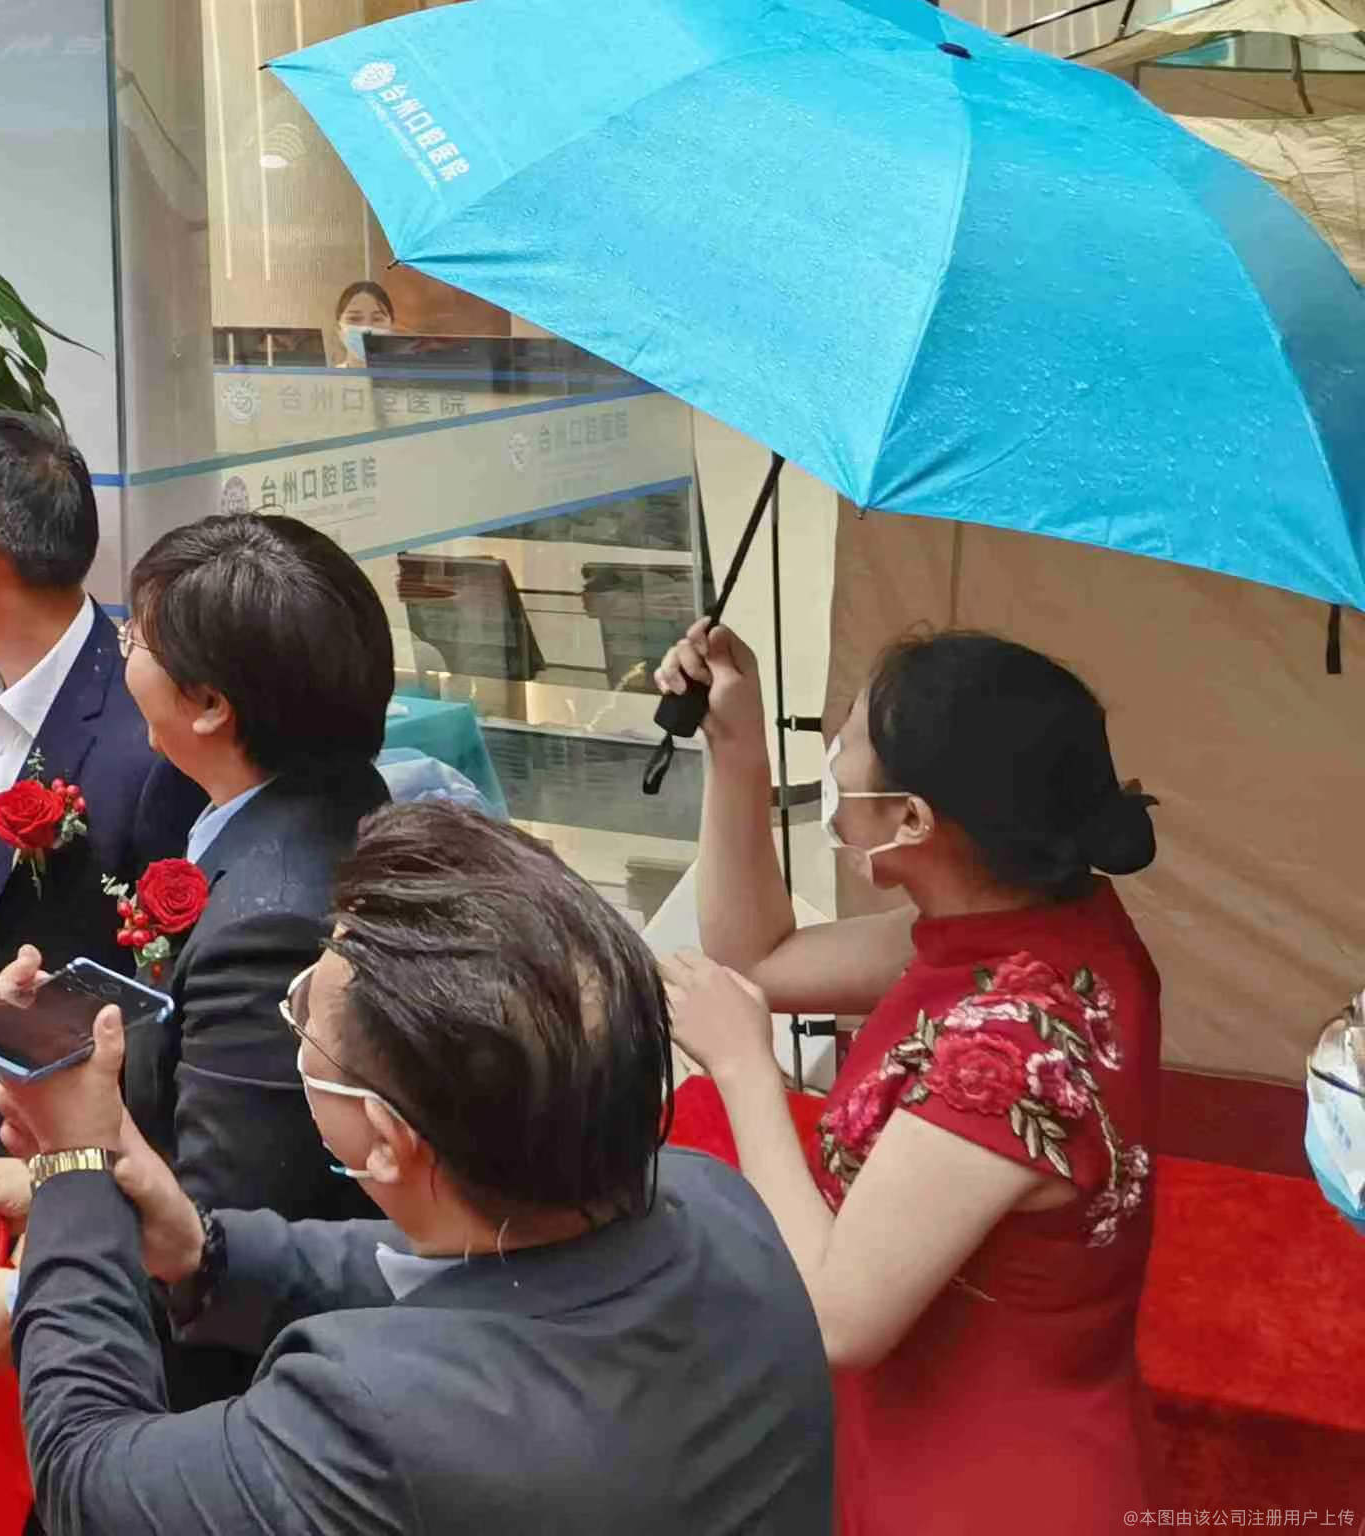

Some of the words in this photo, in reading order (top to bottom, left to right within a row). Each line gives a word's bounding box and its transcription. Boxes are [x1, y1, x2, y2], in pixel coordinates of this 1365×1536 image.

[260, 456, 377, 509] 台州口腔医院
